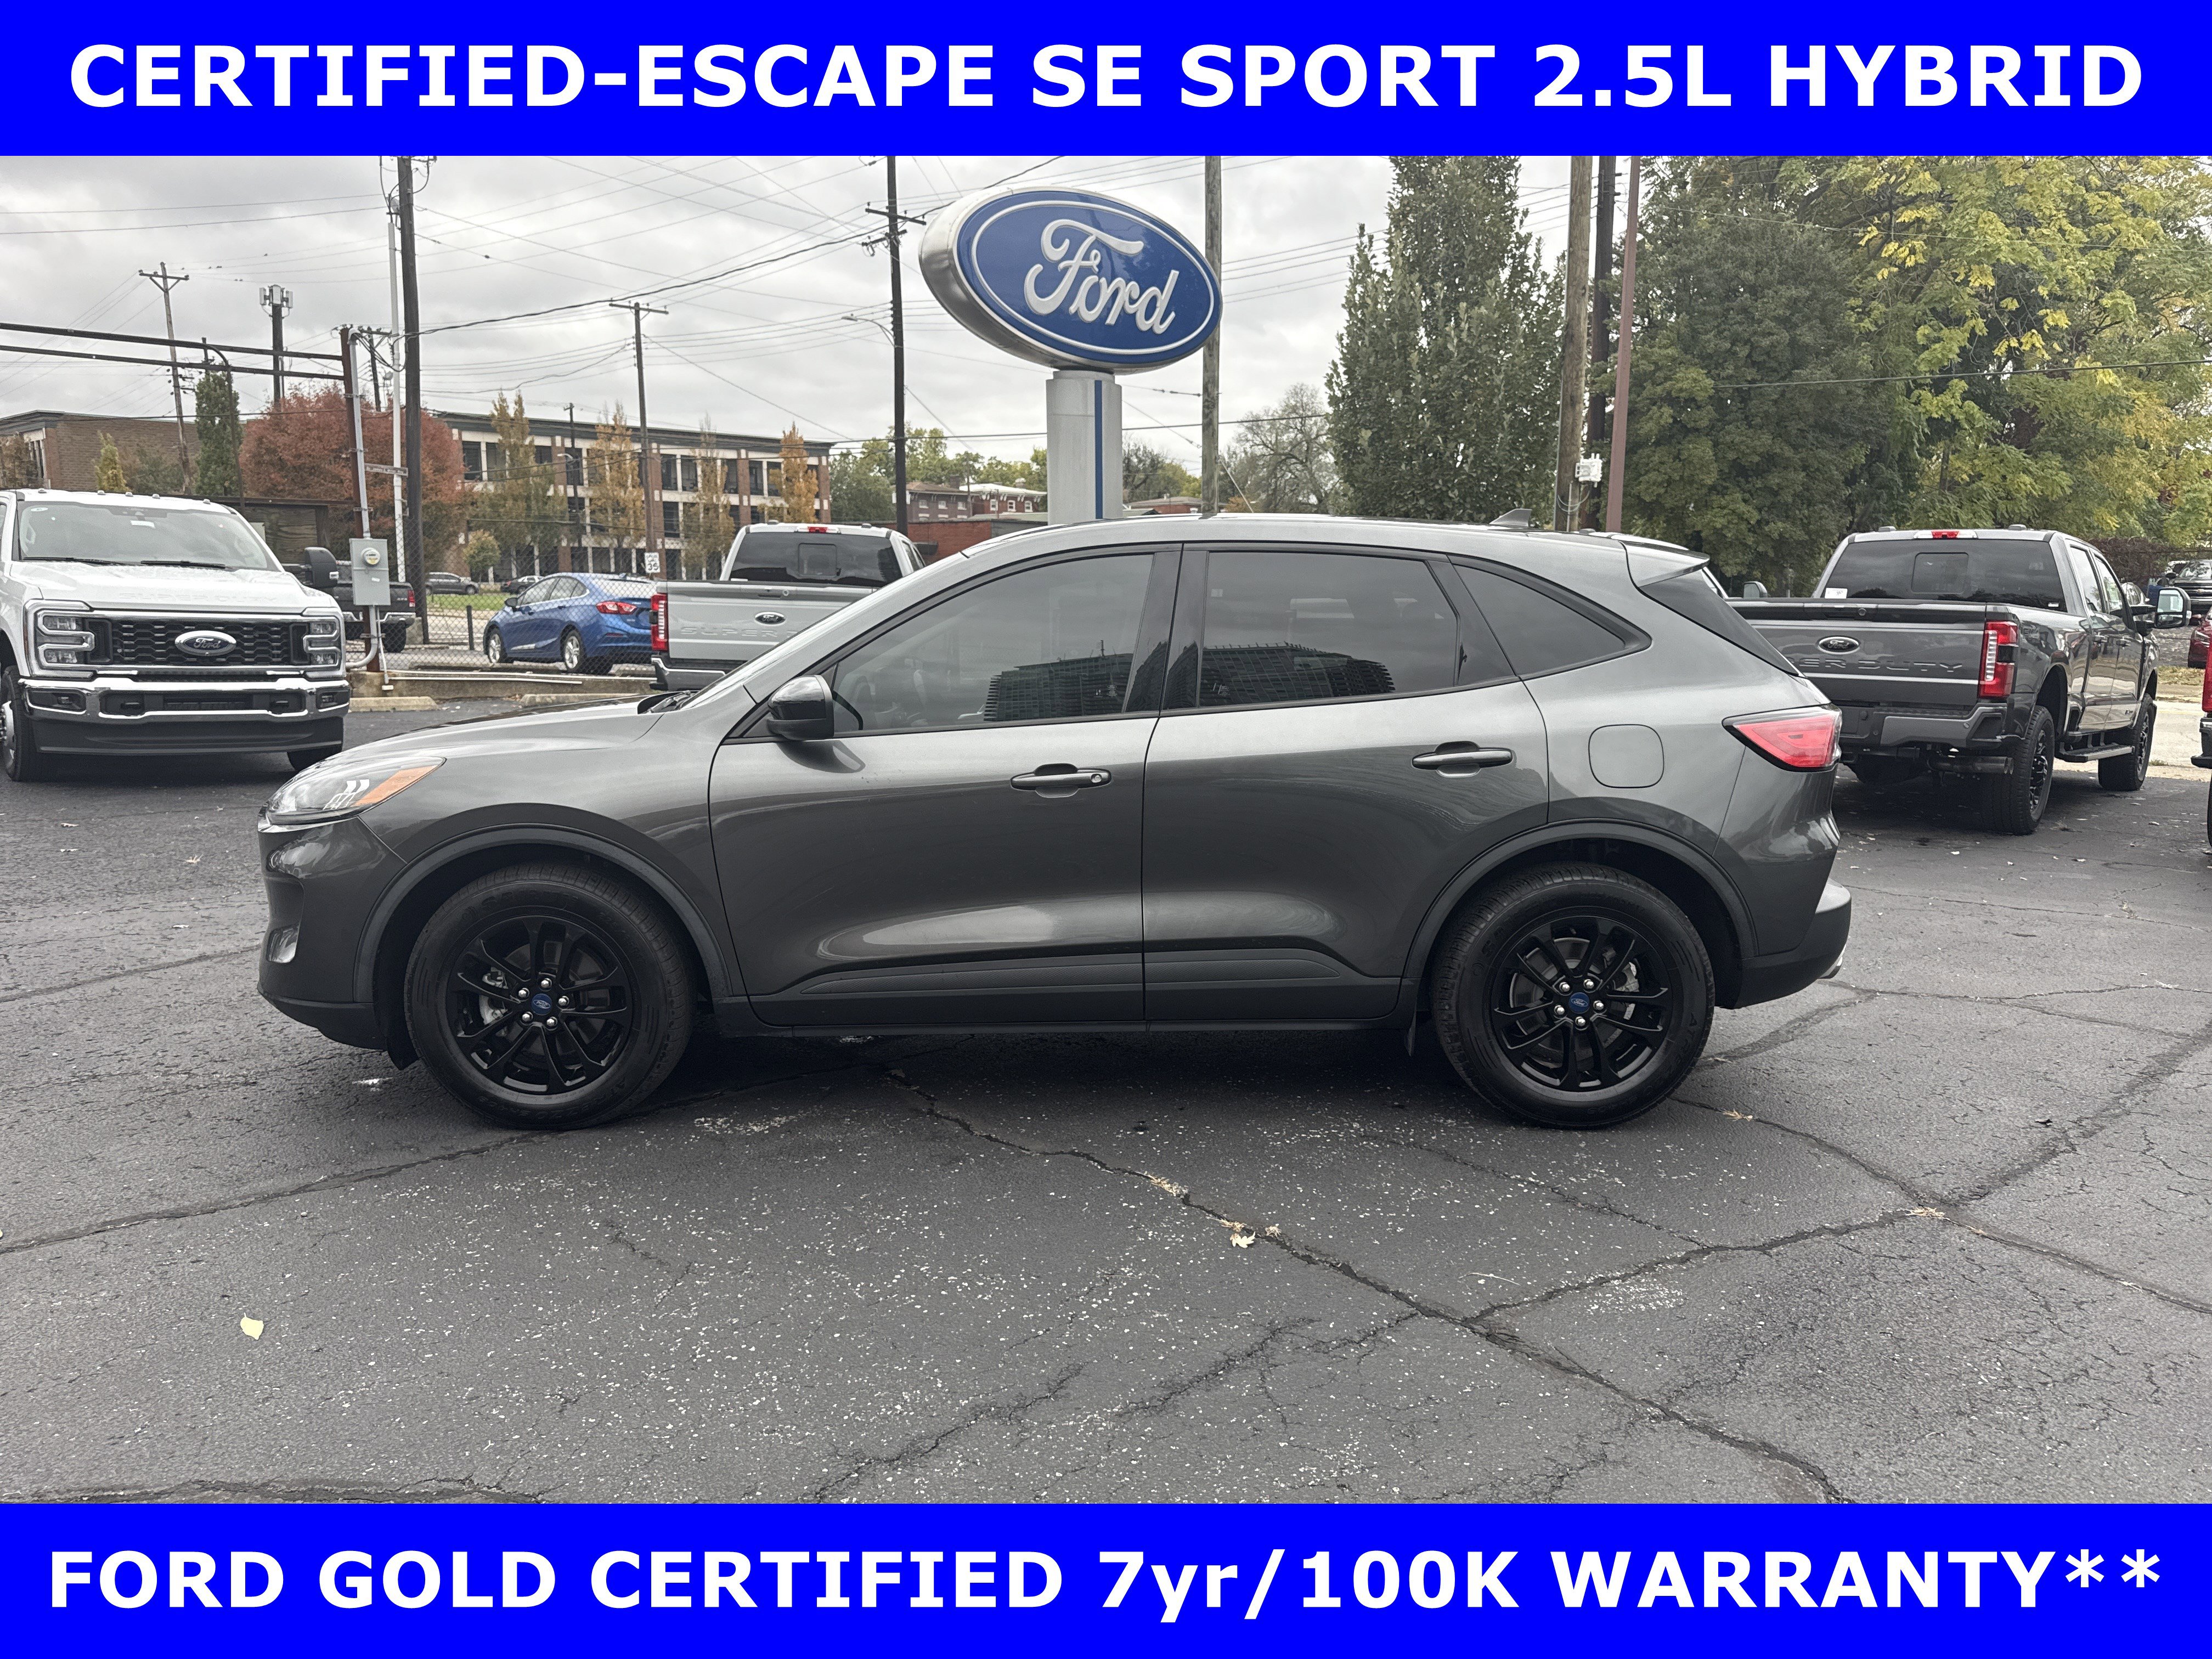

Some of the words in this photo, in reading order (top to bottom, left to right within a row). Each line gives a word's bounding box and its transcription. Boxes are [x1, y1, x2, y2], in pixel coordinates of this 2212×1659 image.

[1024, 219, 1180, 335] Ford
[647, 563, 658, 571] 35
[681, 627, 778, 637] SUPER
[193, 637, 221, 648] Ford
[1827, 640, 1849, 649] Ford
[1858, 659, 1963, 673] DUTY
